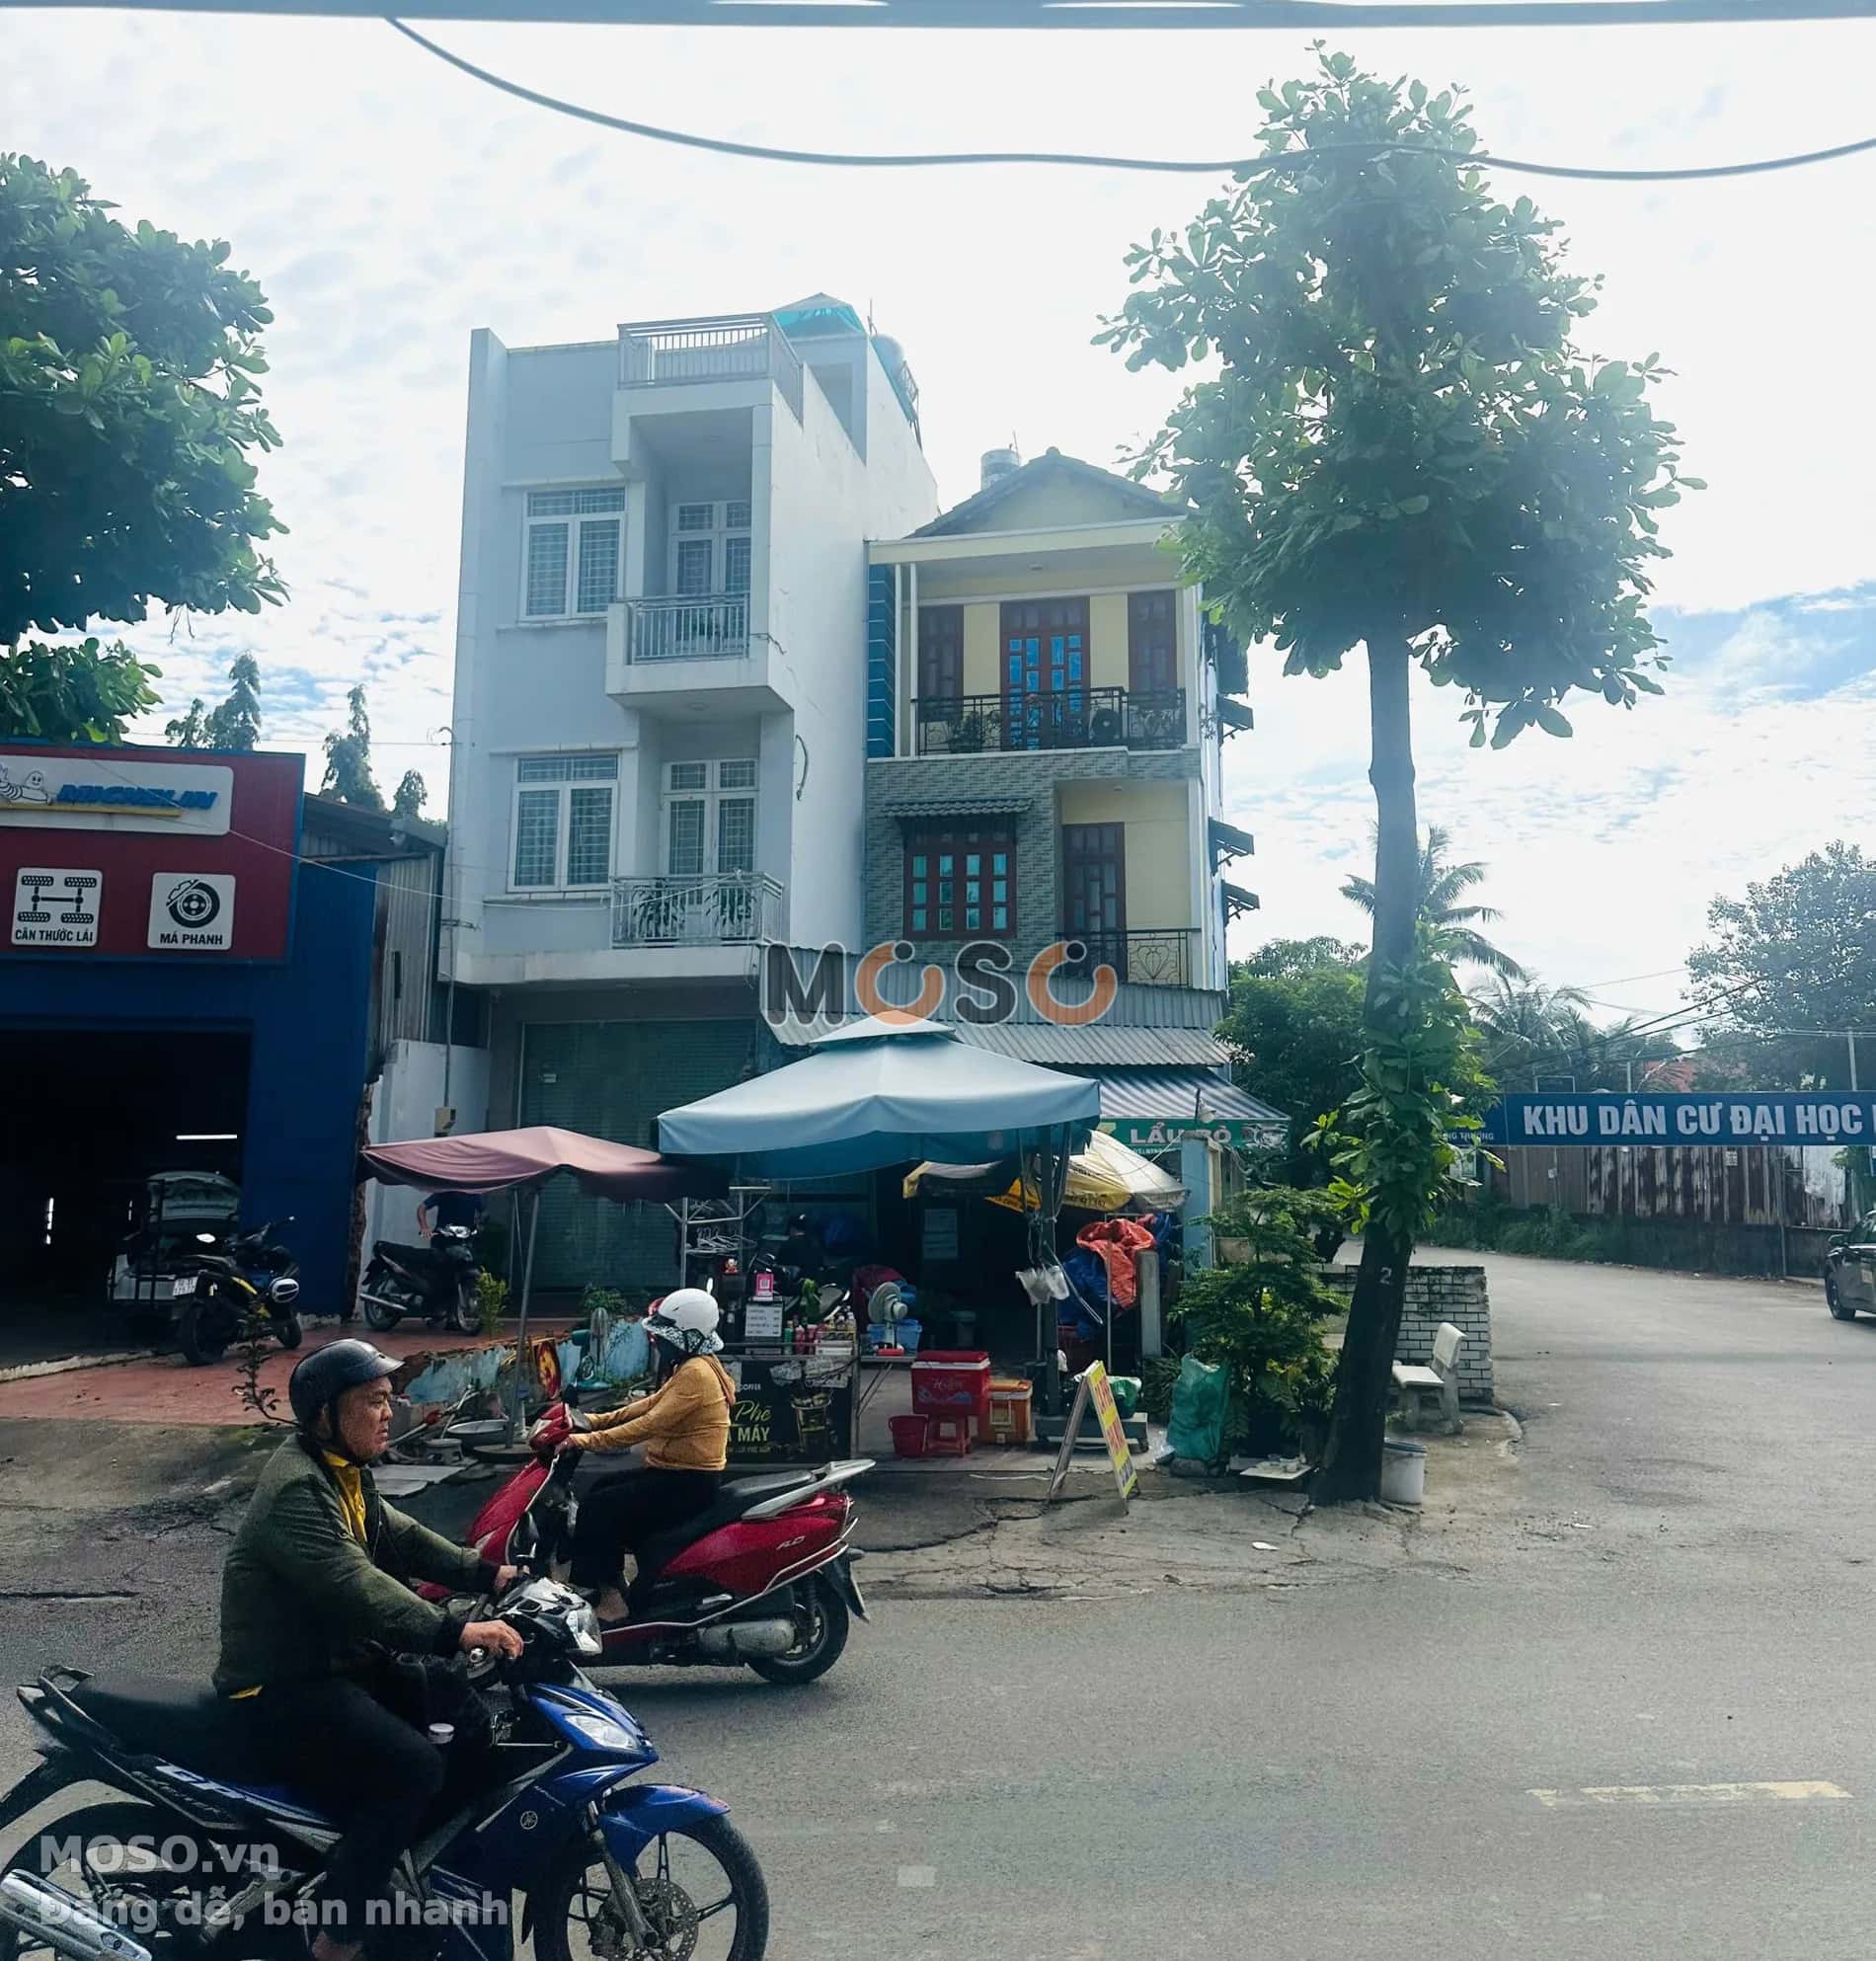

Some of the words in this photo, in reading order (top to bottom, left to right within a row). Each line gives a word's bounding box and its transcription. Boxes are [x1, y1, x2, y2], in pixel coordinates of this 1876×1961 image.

[15, 926, 37, 941] CÂN
[76, 929, 94, 942] LÁI
[160, 931, 179, 945] MÁ
[182, 934, 223, 945] PHANH
[1524, 1105, 1589, 1135] KHU
[1599, 1099, 1668, 1135] DÂN
[1677, 1102, 1723, 1135] CƯ
[1730, 1105, 1786, 1141] ĐẠI
[1795, 1104, 1863, 1141] HỌC
[738, 1424, 770, 1442] MÁY
